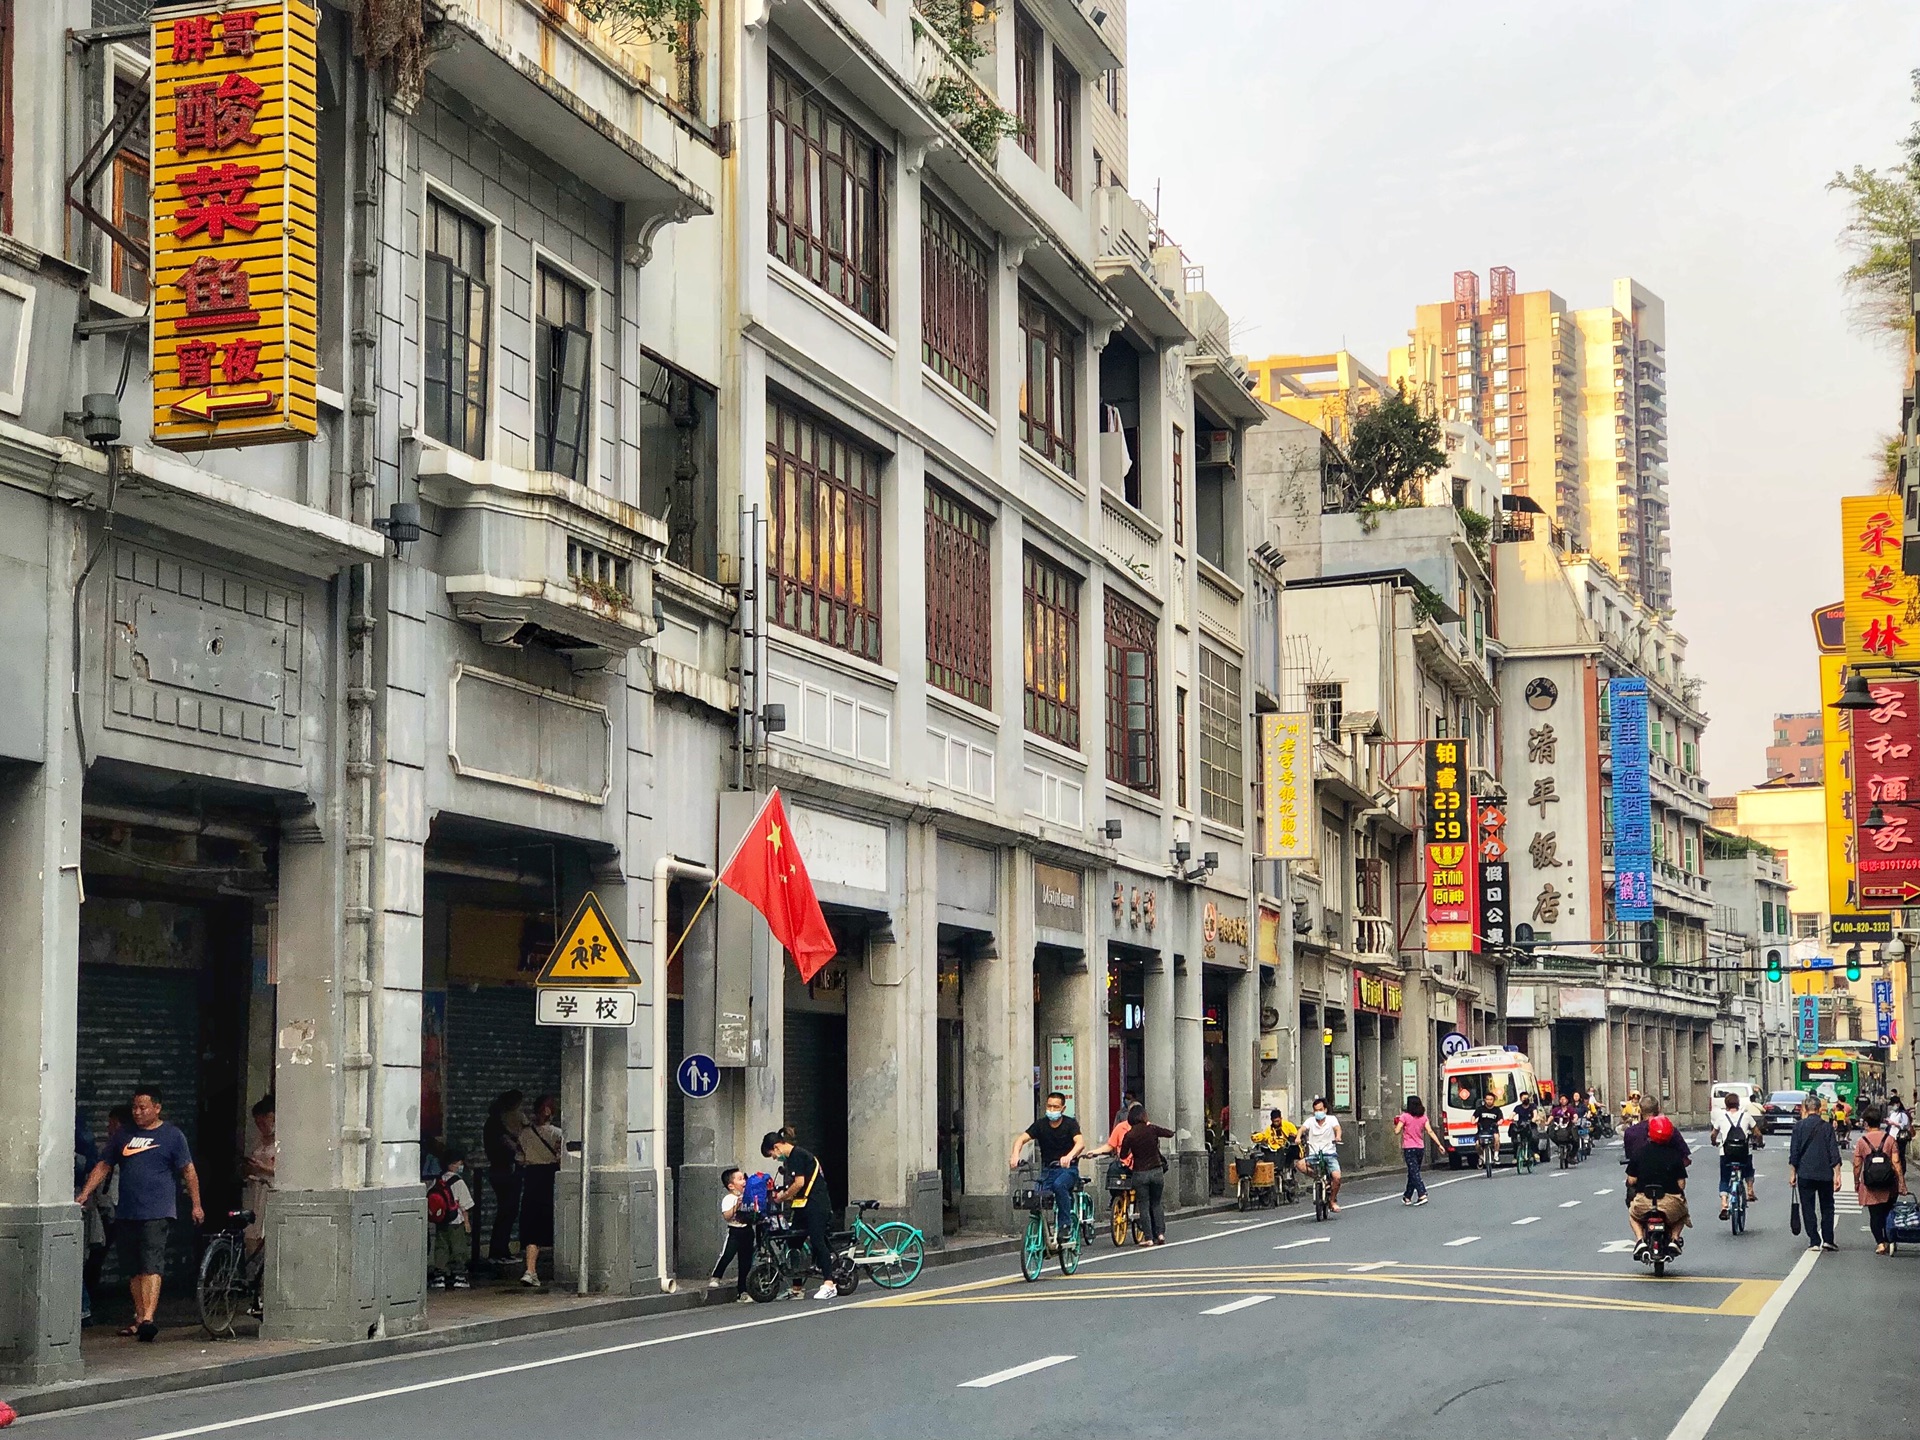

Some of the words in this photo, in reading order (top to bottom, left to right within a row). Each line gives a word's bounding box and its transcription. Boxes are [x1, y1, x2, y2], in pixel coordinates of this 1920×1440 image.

[172, 11, 261, 62] 胖哥
[174, 73, 264, 330] 酸菜鱼
[177, 338, 263, 386] 宵夜
[1858, 512, 1909, 658] 采芝林
[1274, 722, 1300, 738] 广州
[1435, 743, 1457, 789] 铂睿
[1617, 698, 1644, 843] 凯里亚德酒店
[1865, 686, 1914, 852] 家和酒家
[1277, 738, 1299, 849] 老字号银记肠粉
[1432, 870, 1464, 886] 武林
[1433, 889, 1464, 905] 厨神
[1485, 866, 1504, 945] 假日公寓
[1840, 921, 1890, 933] 400-820-3333
[555, 995, 618, 1019] 学校
[1446, 1040, 1464, 1054] 30
[128, 1137, 154, 1147] NIKE
